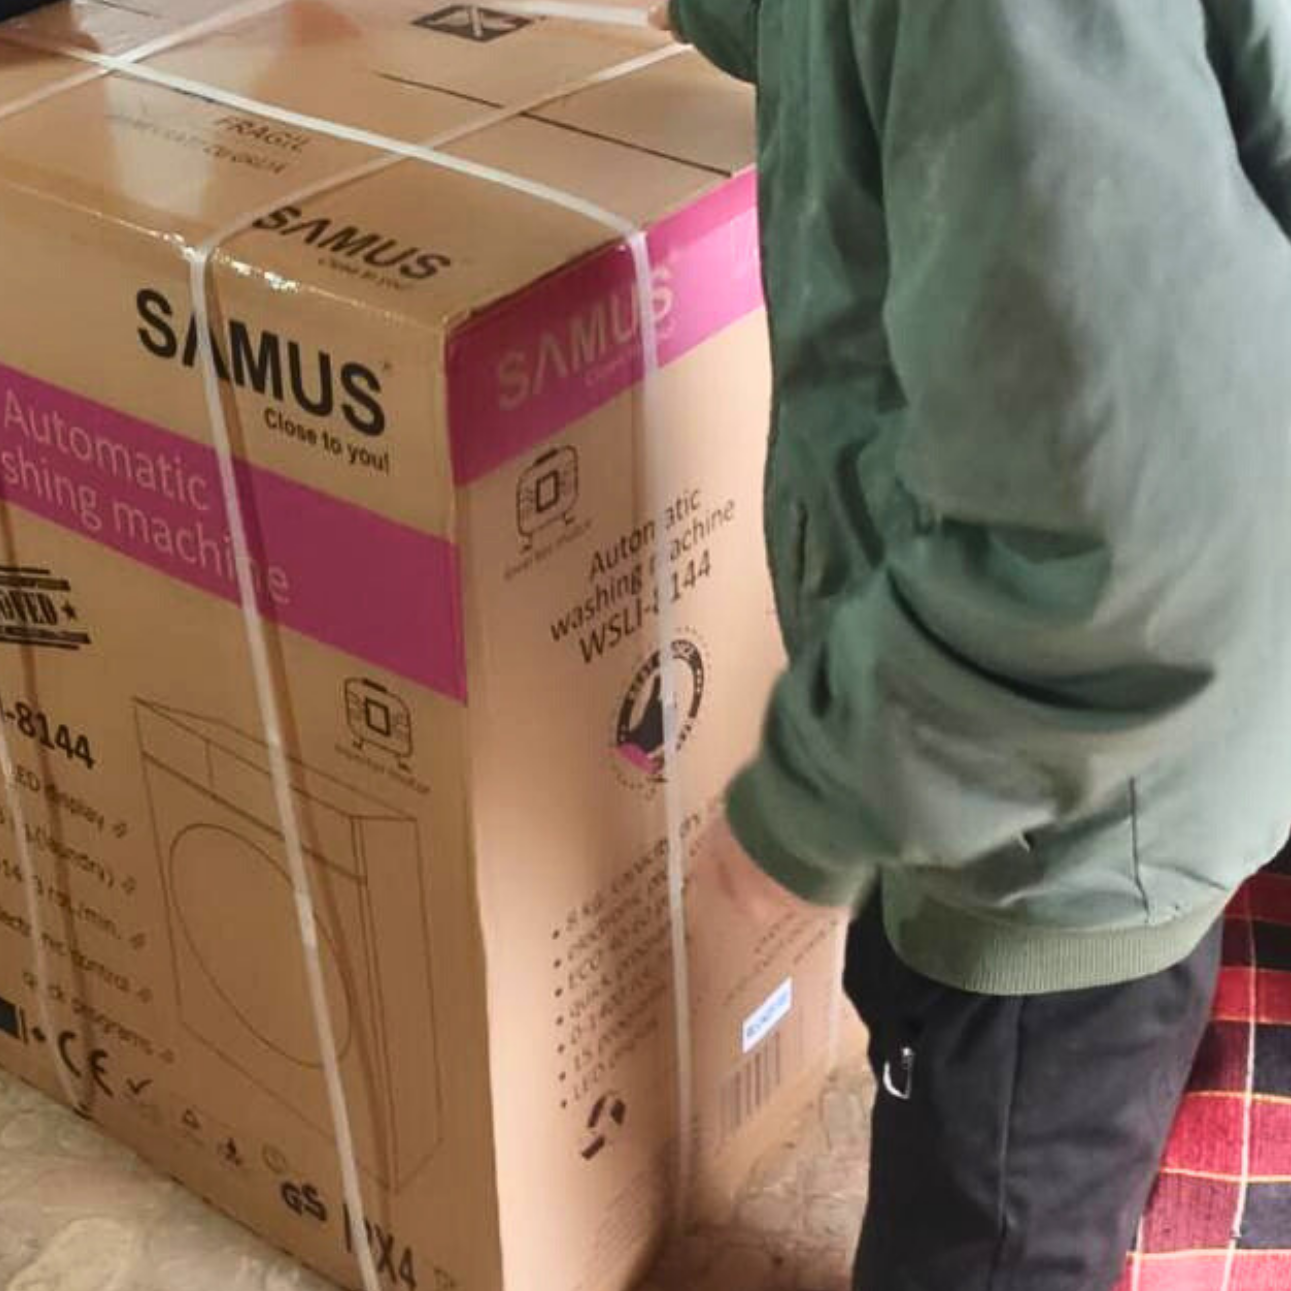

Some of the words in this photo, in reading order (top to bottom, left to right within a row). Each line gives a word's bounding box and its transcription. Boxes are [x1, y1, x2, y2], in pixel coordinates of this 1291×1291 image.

[251, 205, 452, 280] SAMUS
[135, 287, 386, 437] SAMUS
[3, 388, 209, 511] Automatic
[264, 406, 317, 445] Close
[322, 430, 344, 456] to
[346, 442, 390, 474] you!
[550, 563, 644, 643] washing
[280, 1181, 328, 1222] GS
[343, 1202, 418, 1291] IX4
